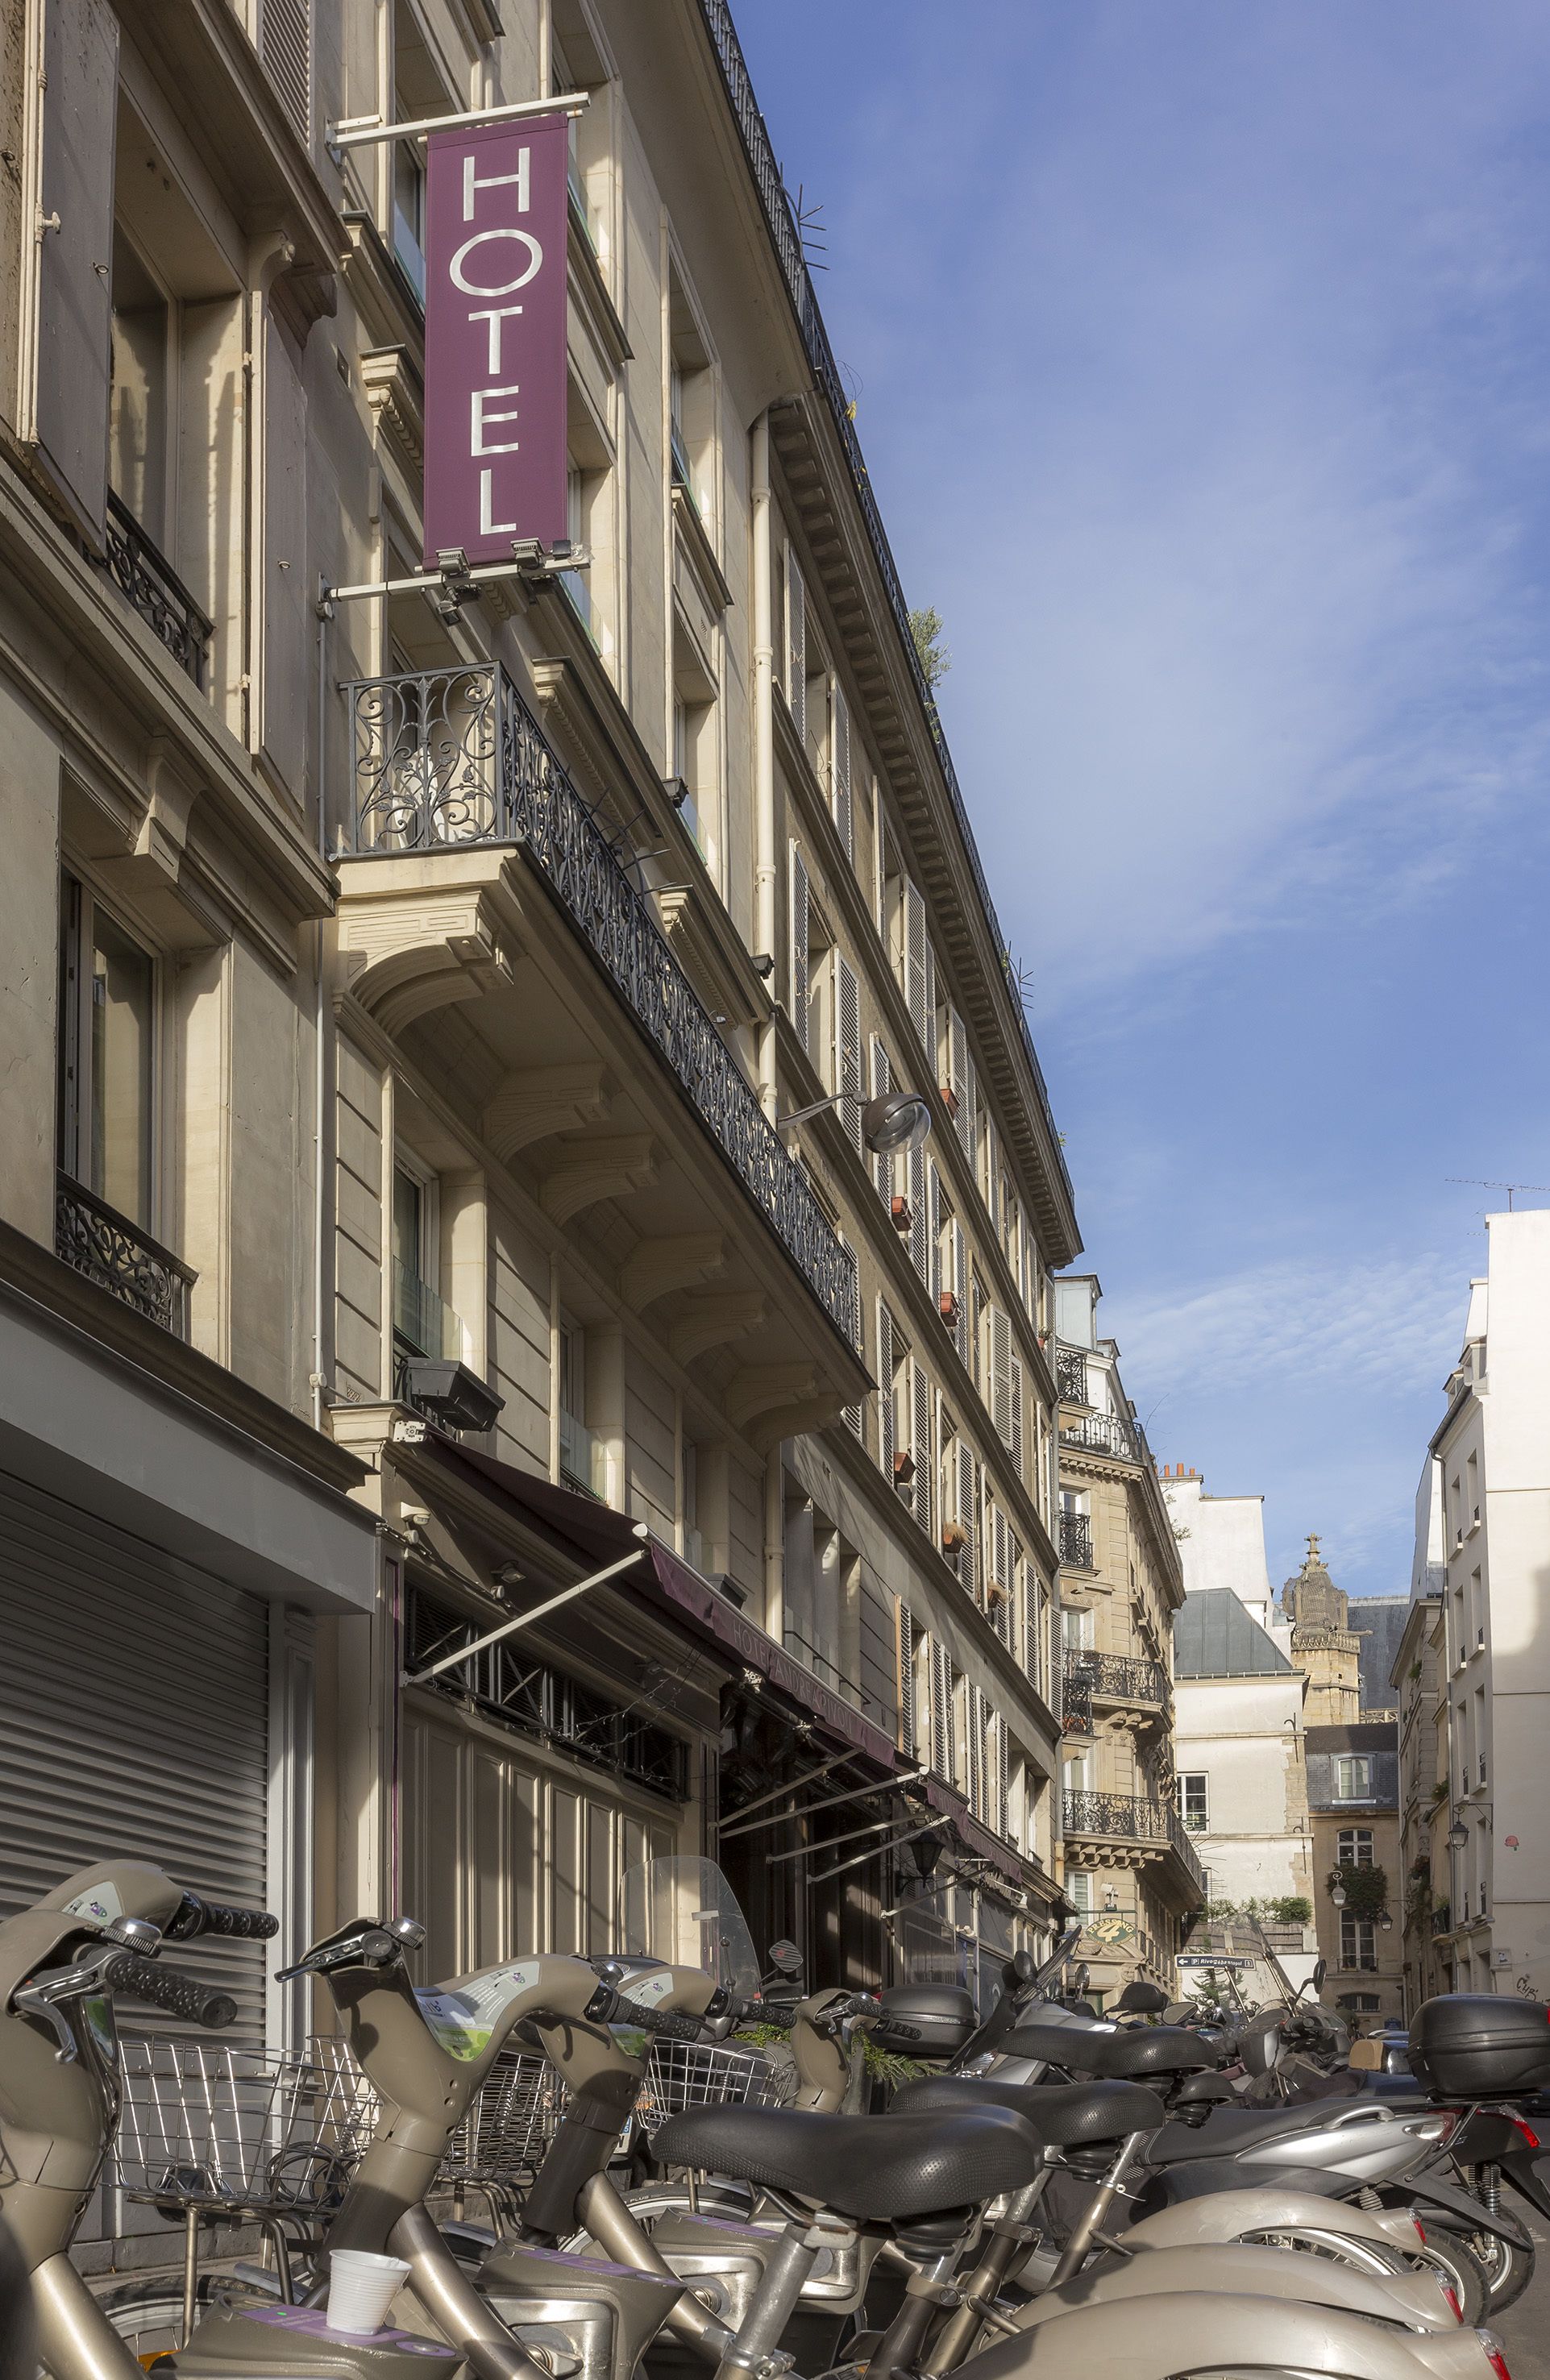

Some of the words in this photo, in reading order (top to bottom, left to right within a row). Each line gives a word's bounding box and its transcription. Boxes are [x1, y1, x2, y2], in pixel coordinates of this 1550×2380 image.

[449, 147, 544, 535] HOTEL
[1087, 1919, 1135, 1934] PRESSING
[1097, 1920, 1120, 1942] 4
